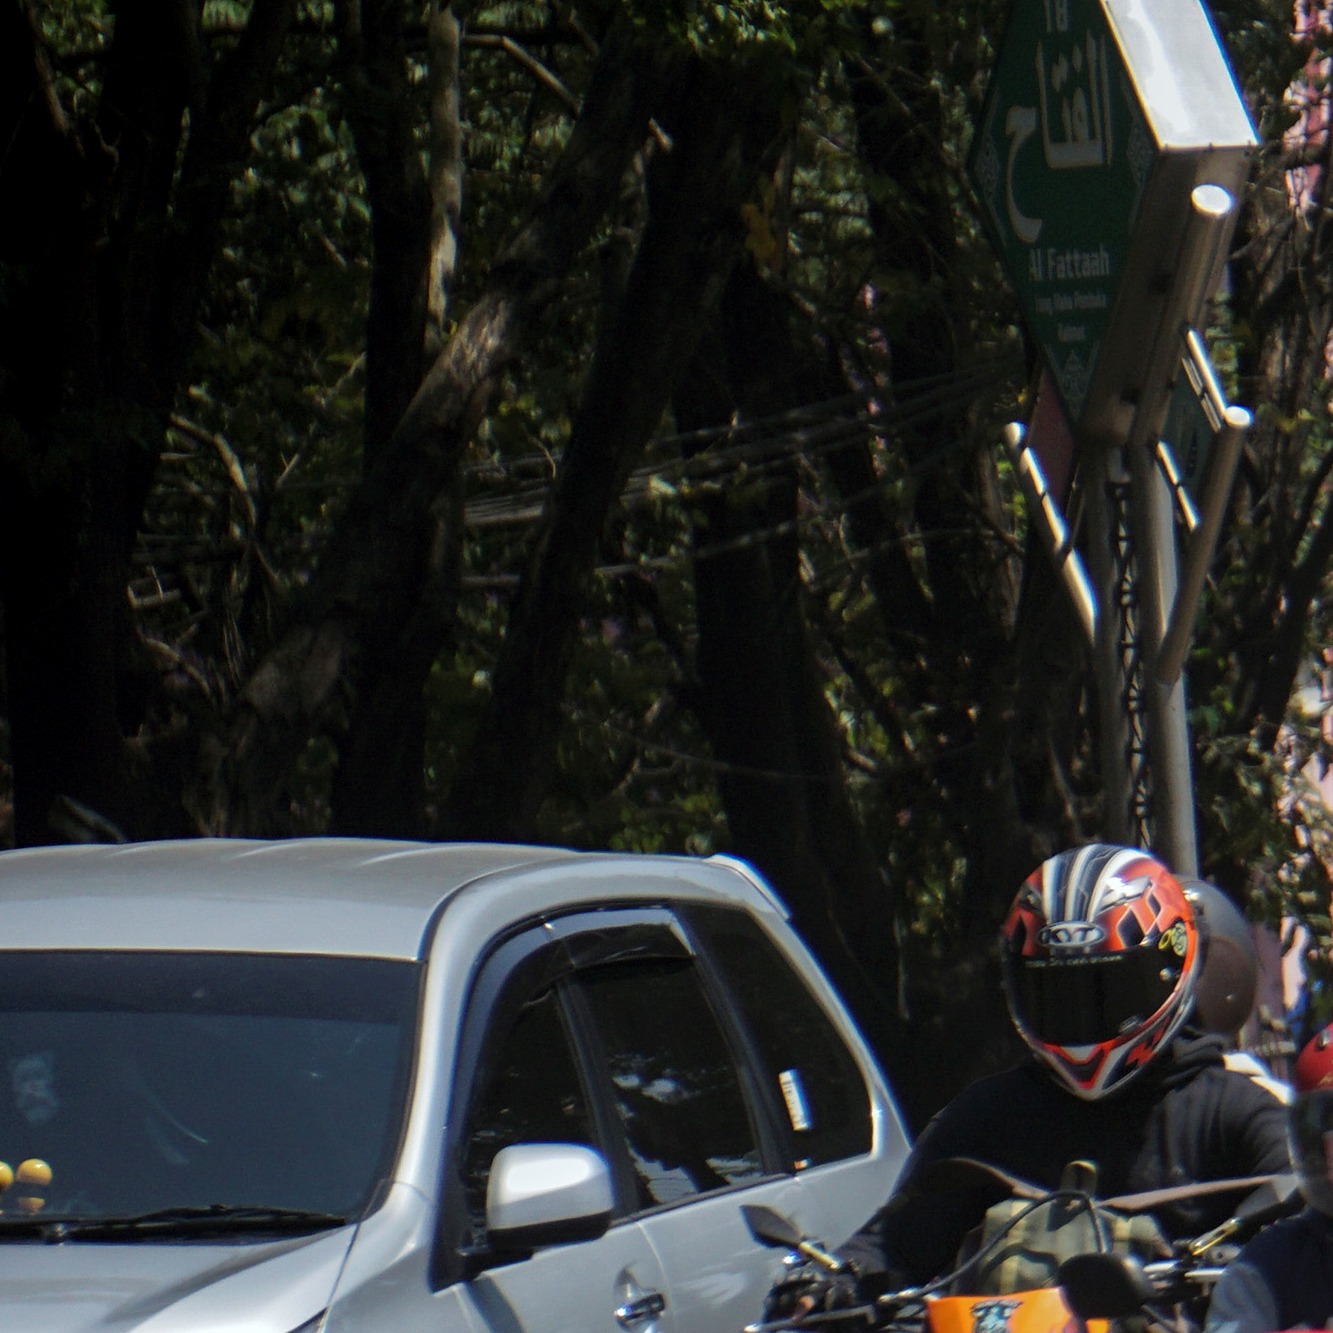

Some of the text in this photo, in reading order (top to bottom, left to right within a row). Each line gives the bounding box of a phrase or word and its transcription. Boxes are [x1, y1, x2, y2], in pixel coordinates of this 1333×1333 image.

[1028, 243, 1110, 281] Al Fattaah
[1039, 926, 1096, 945] KYT
